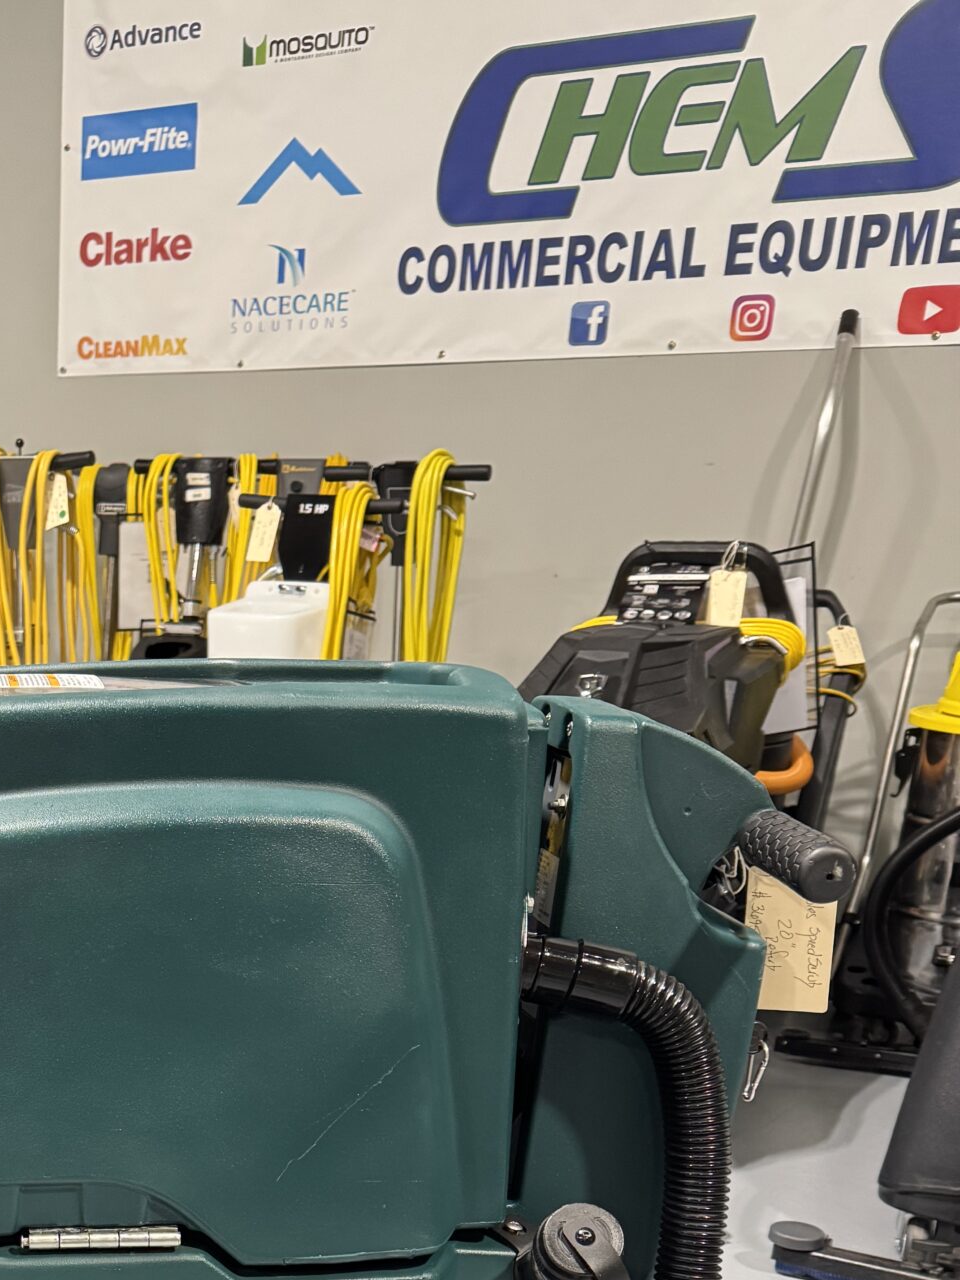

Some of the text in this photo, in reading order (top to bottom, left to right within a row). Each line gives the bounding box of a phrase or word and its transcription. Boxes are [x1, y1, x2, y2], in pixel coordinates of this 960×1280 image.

[109, 22, 202, 50] Advance
[84, 126, 190, 160] Powr-Flite
[80, 227, 192, 268] Clarke
[398, 207, 960, 295] COMMERCIAL EQUIPME
[230, 291, 350, 318] NACECARE
[230, 315, 349, 335] SOLUTIONS
[314, 503, 330, 514] HP
